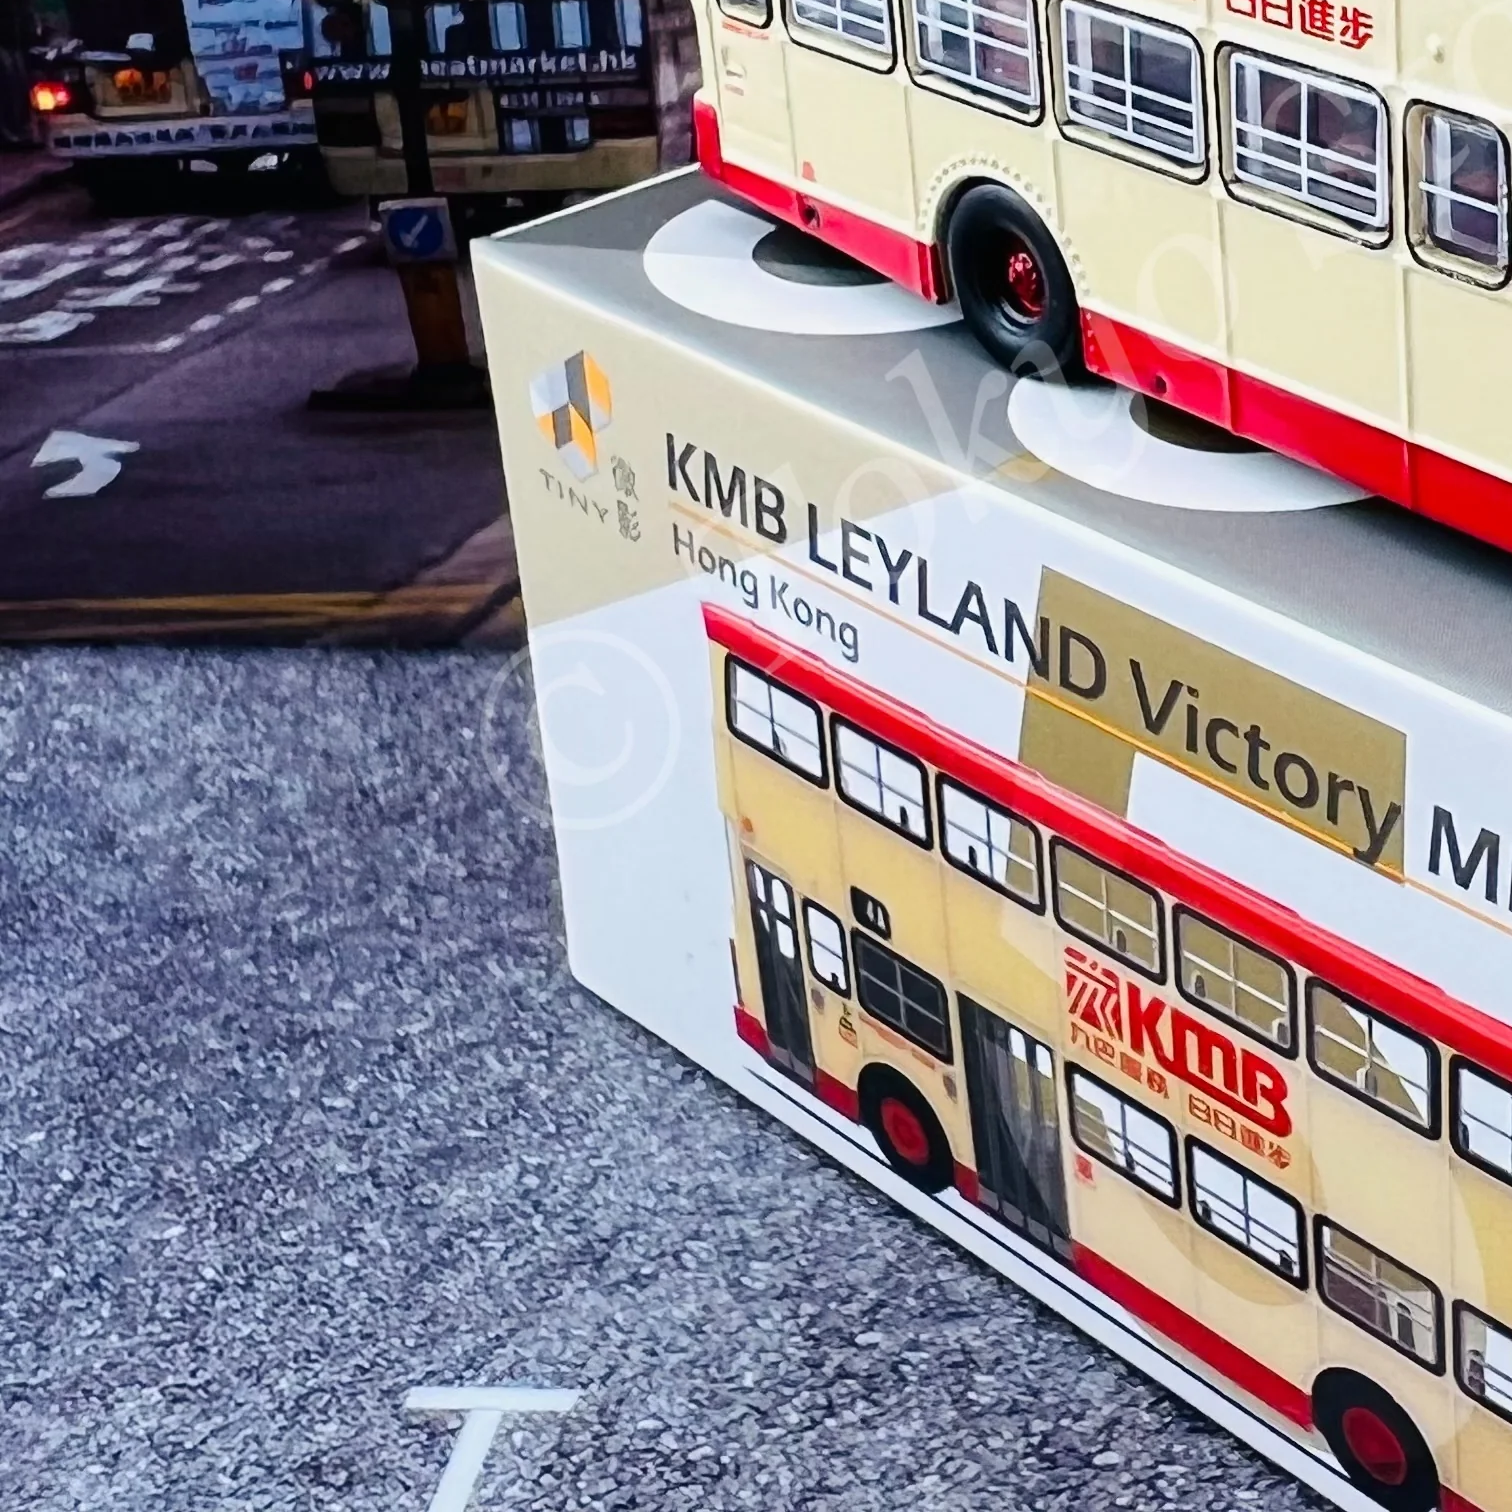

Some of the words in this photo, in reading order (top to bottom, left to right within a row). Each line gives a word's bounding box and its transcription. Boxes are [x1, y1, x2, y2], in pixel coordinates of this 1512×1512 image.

[539, 468, 609, 524] TINY
[666, 432, 787, 544] KMB
[807, 501, 1107, 701] LEYLAND
[1130, 658, 1402, 868] Victory
[672, 522, 759, 609] Hong
[769, 575, 860, 665] Kong
[1126, 981, 1293, 1137] KMB
